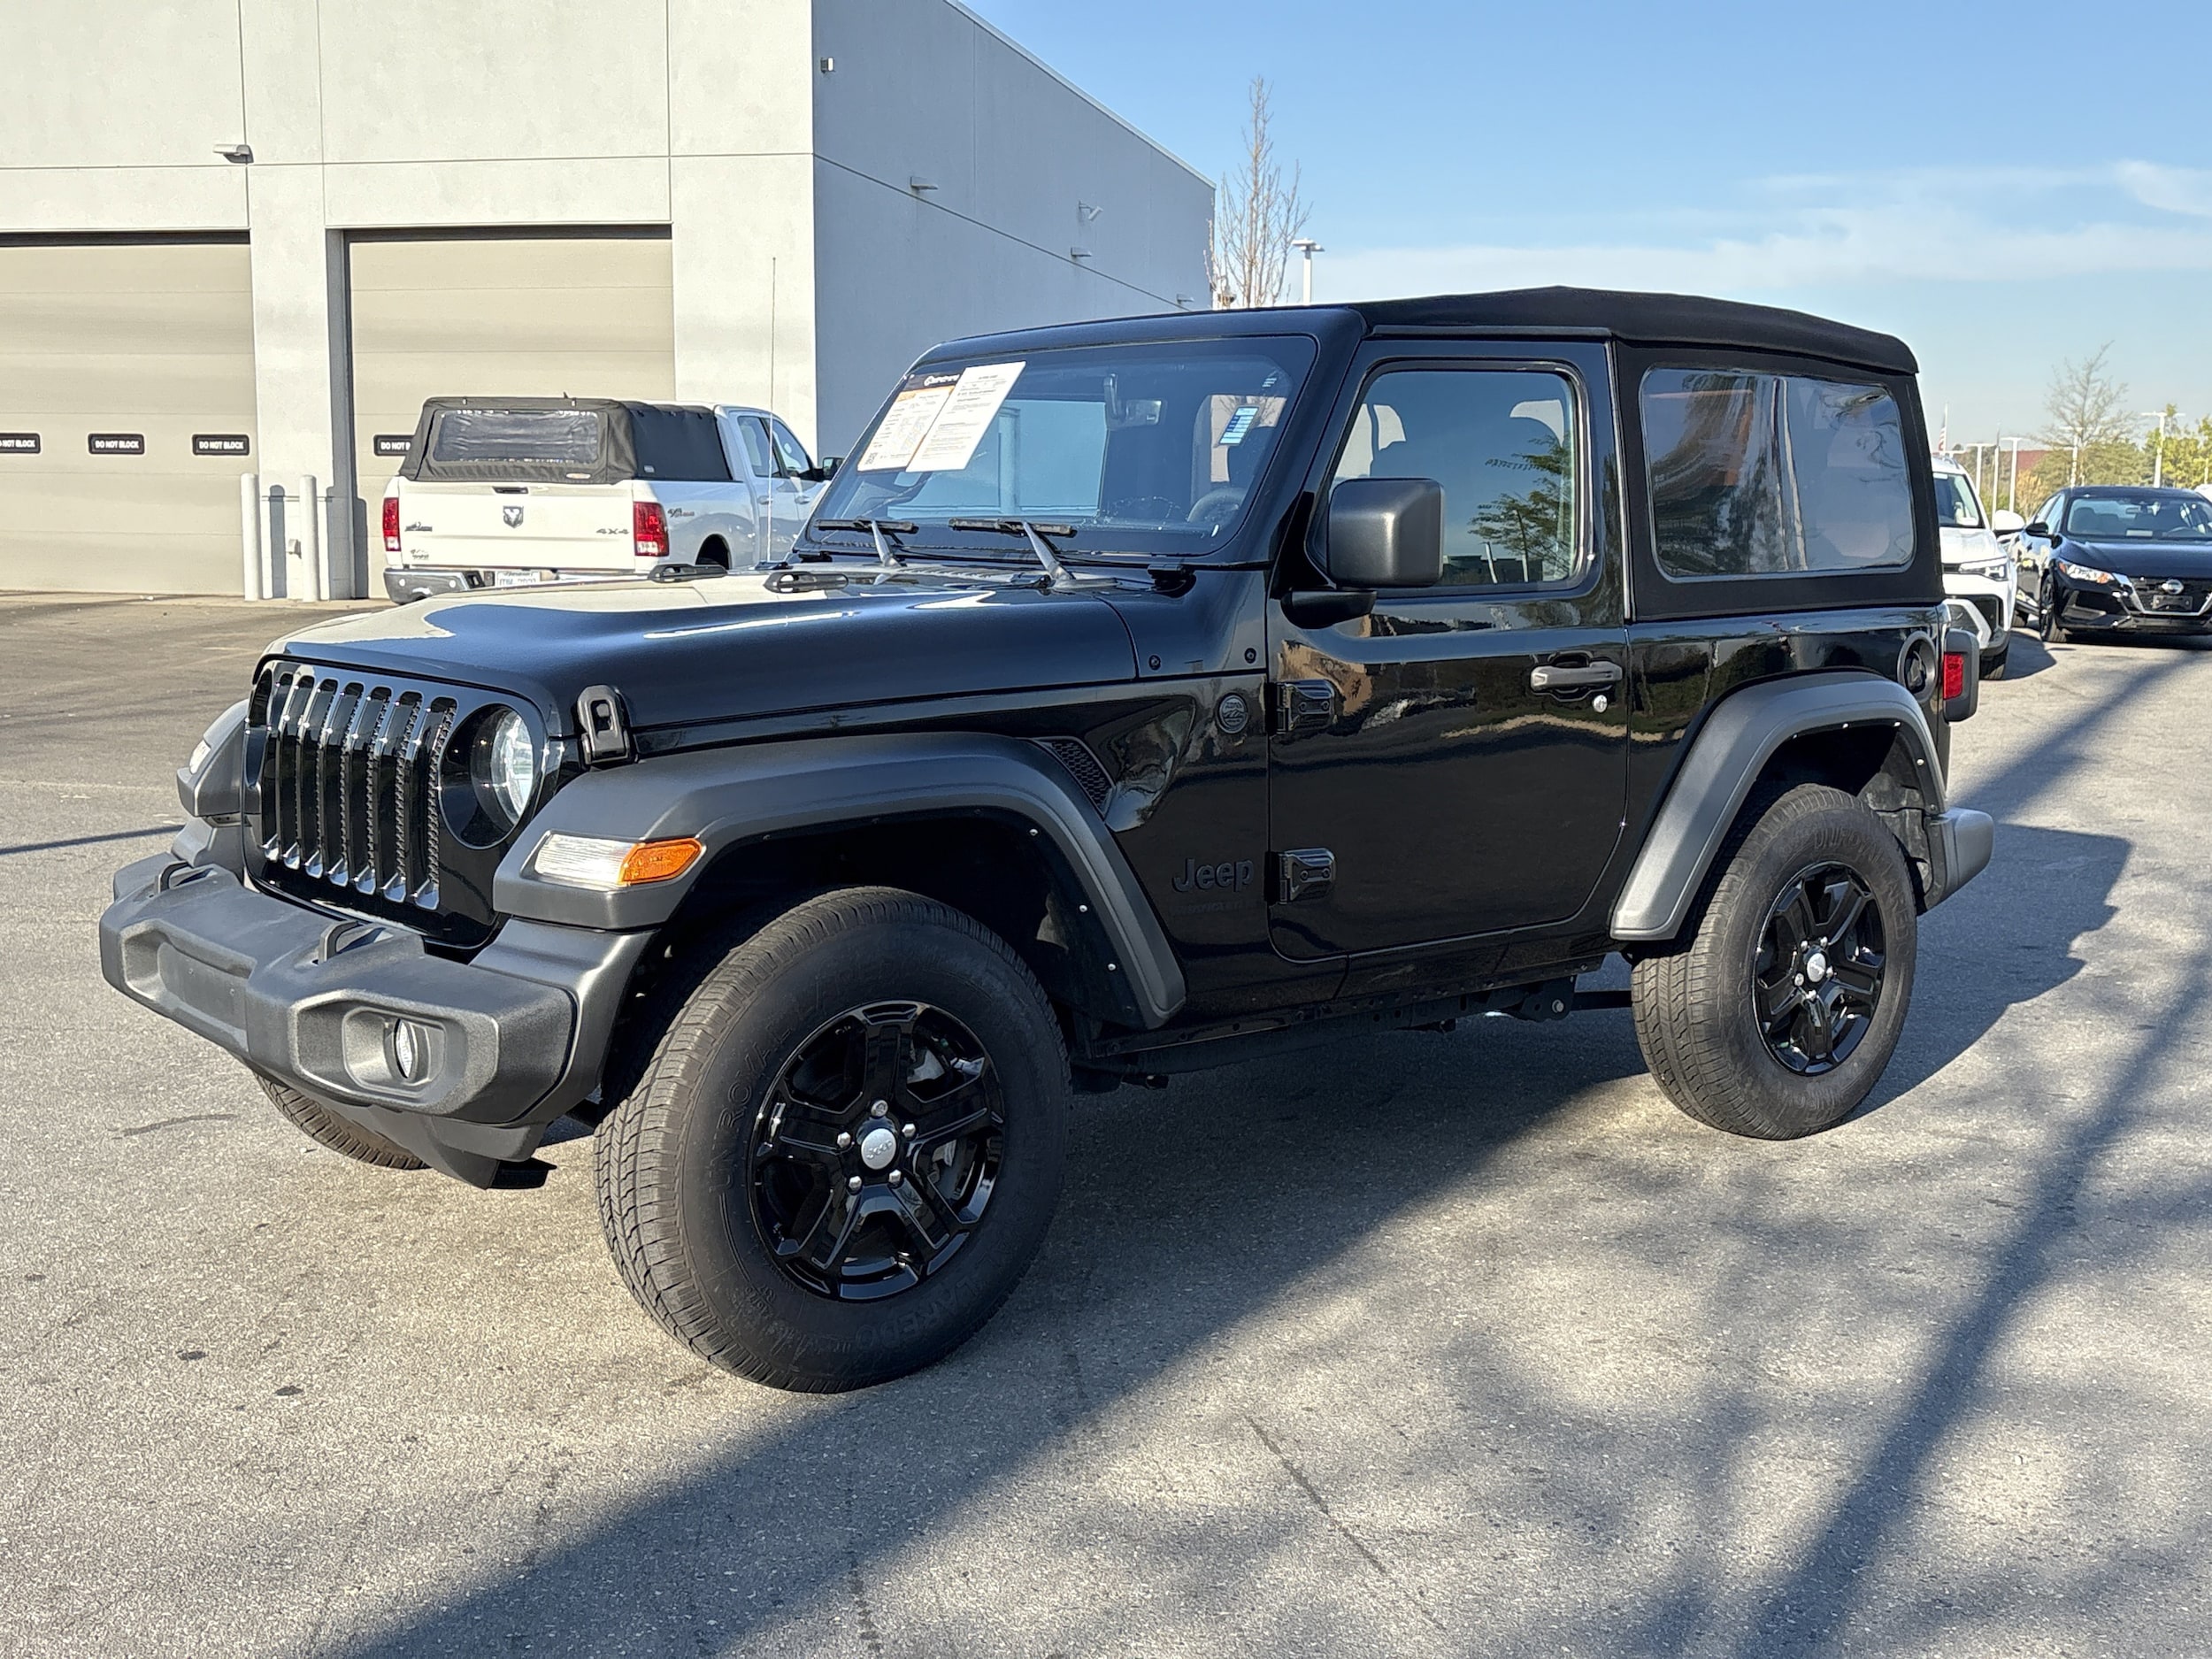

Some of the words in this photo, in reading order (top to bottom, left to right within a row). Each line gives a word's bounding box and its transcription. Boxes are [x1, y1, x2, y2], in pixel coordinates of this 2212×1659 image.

[2, 439, 14, 448] NOT
[15, 439, 35, 448] BLOCK
[95, 440, 104, 449] DO
[105, 440, 118, 449] NOT
[119, 440, 139, 449] BLOCK
[198, 441, 208, 449] DO
[209, 441, 222, 449] NOT
[223, 441, 243, 449] BLOCK
[380, 442, 390, 450] DO
[392, 442, 404, 450] NOT
[1171, 857, 1254, 893] Jeep
